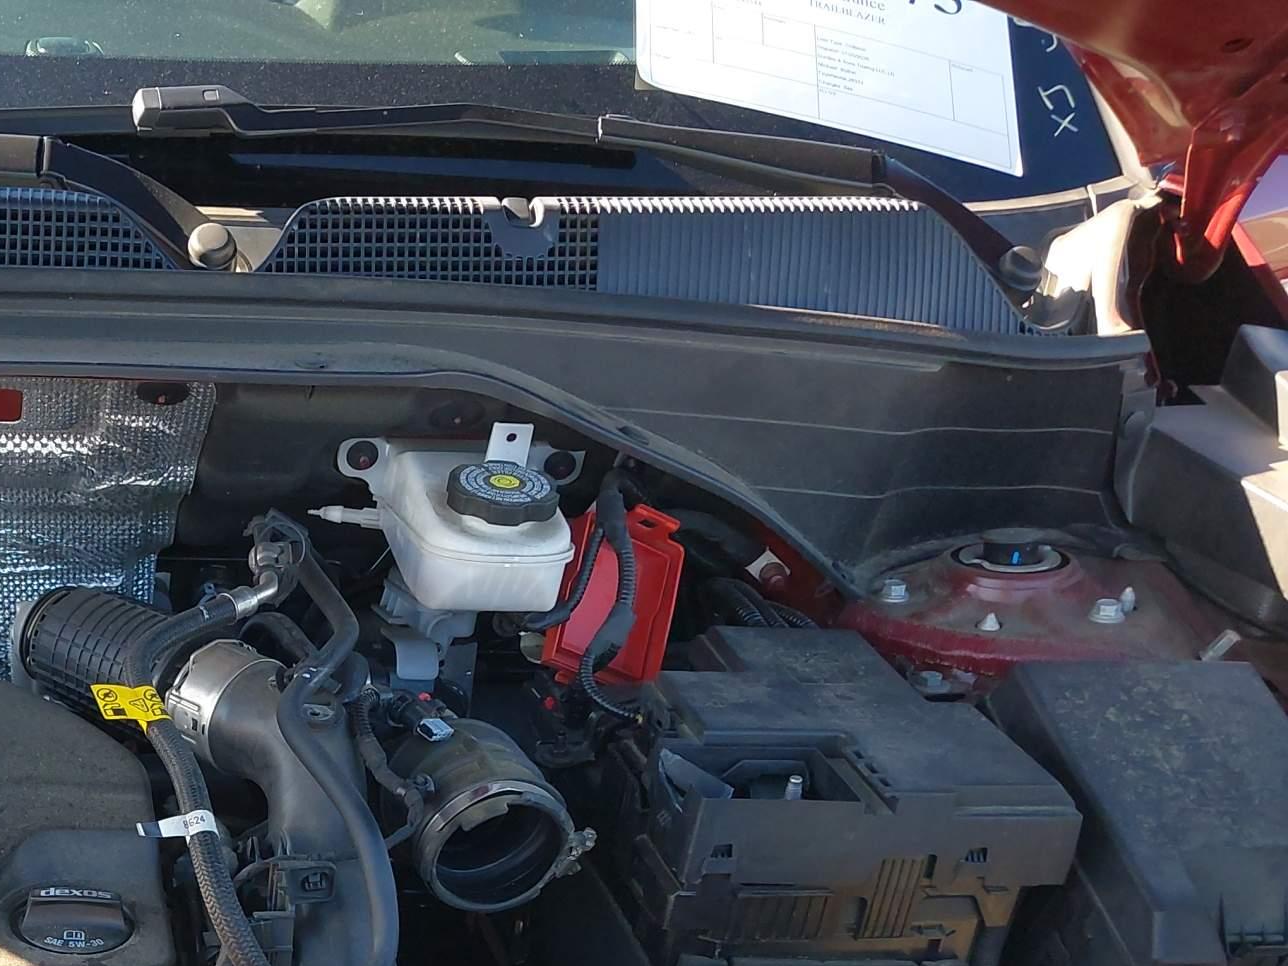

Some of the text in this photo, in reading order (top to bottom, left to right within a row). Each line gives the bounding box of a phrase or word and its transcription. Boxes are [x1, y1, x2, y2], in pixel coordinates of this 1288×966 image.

[40, 887, 113, 899] dexos
[43, 936, 105, 948] SAE 5W-30
